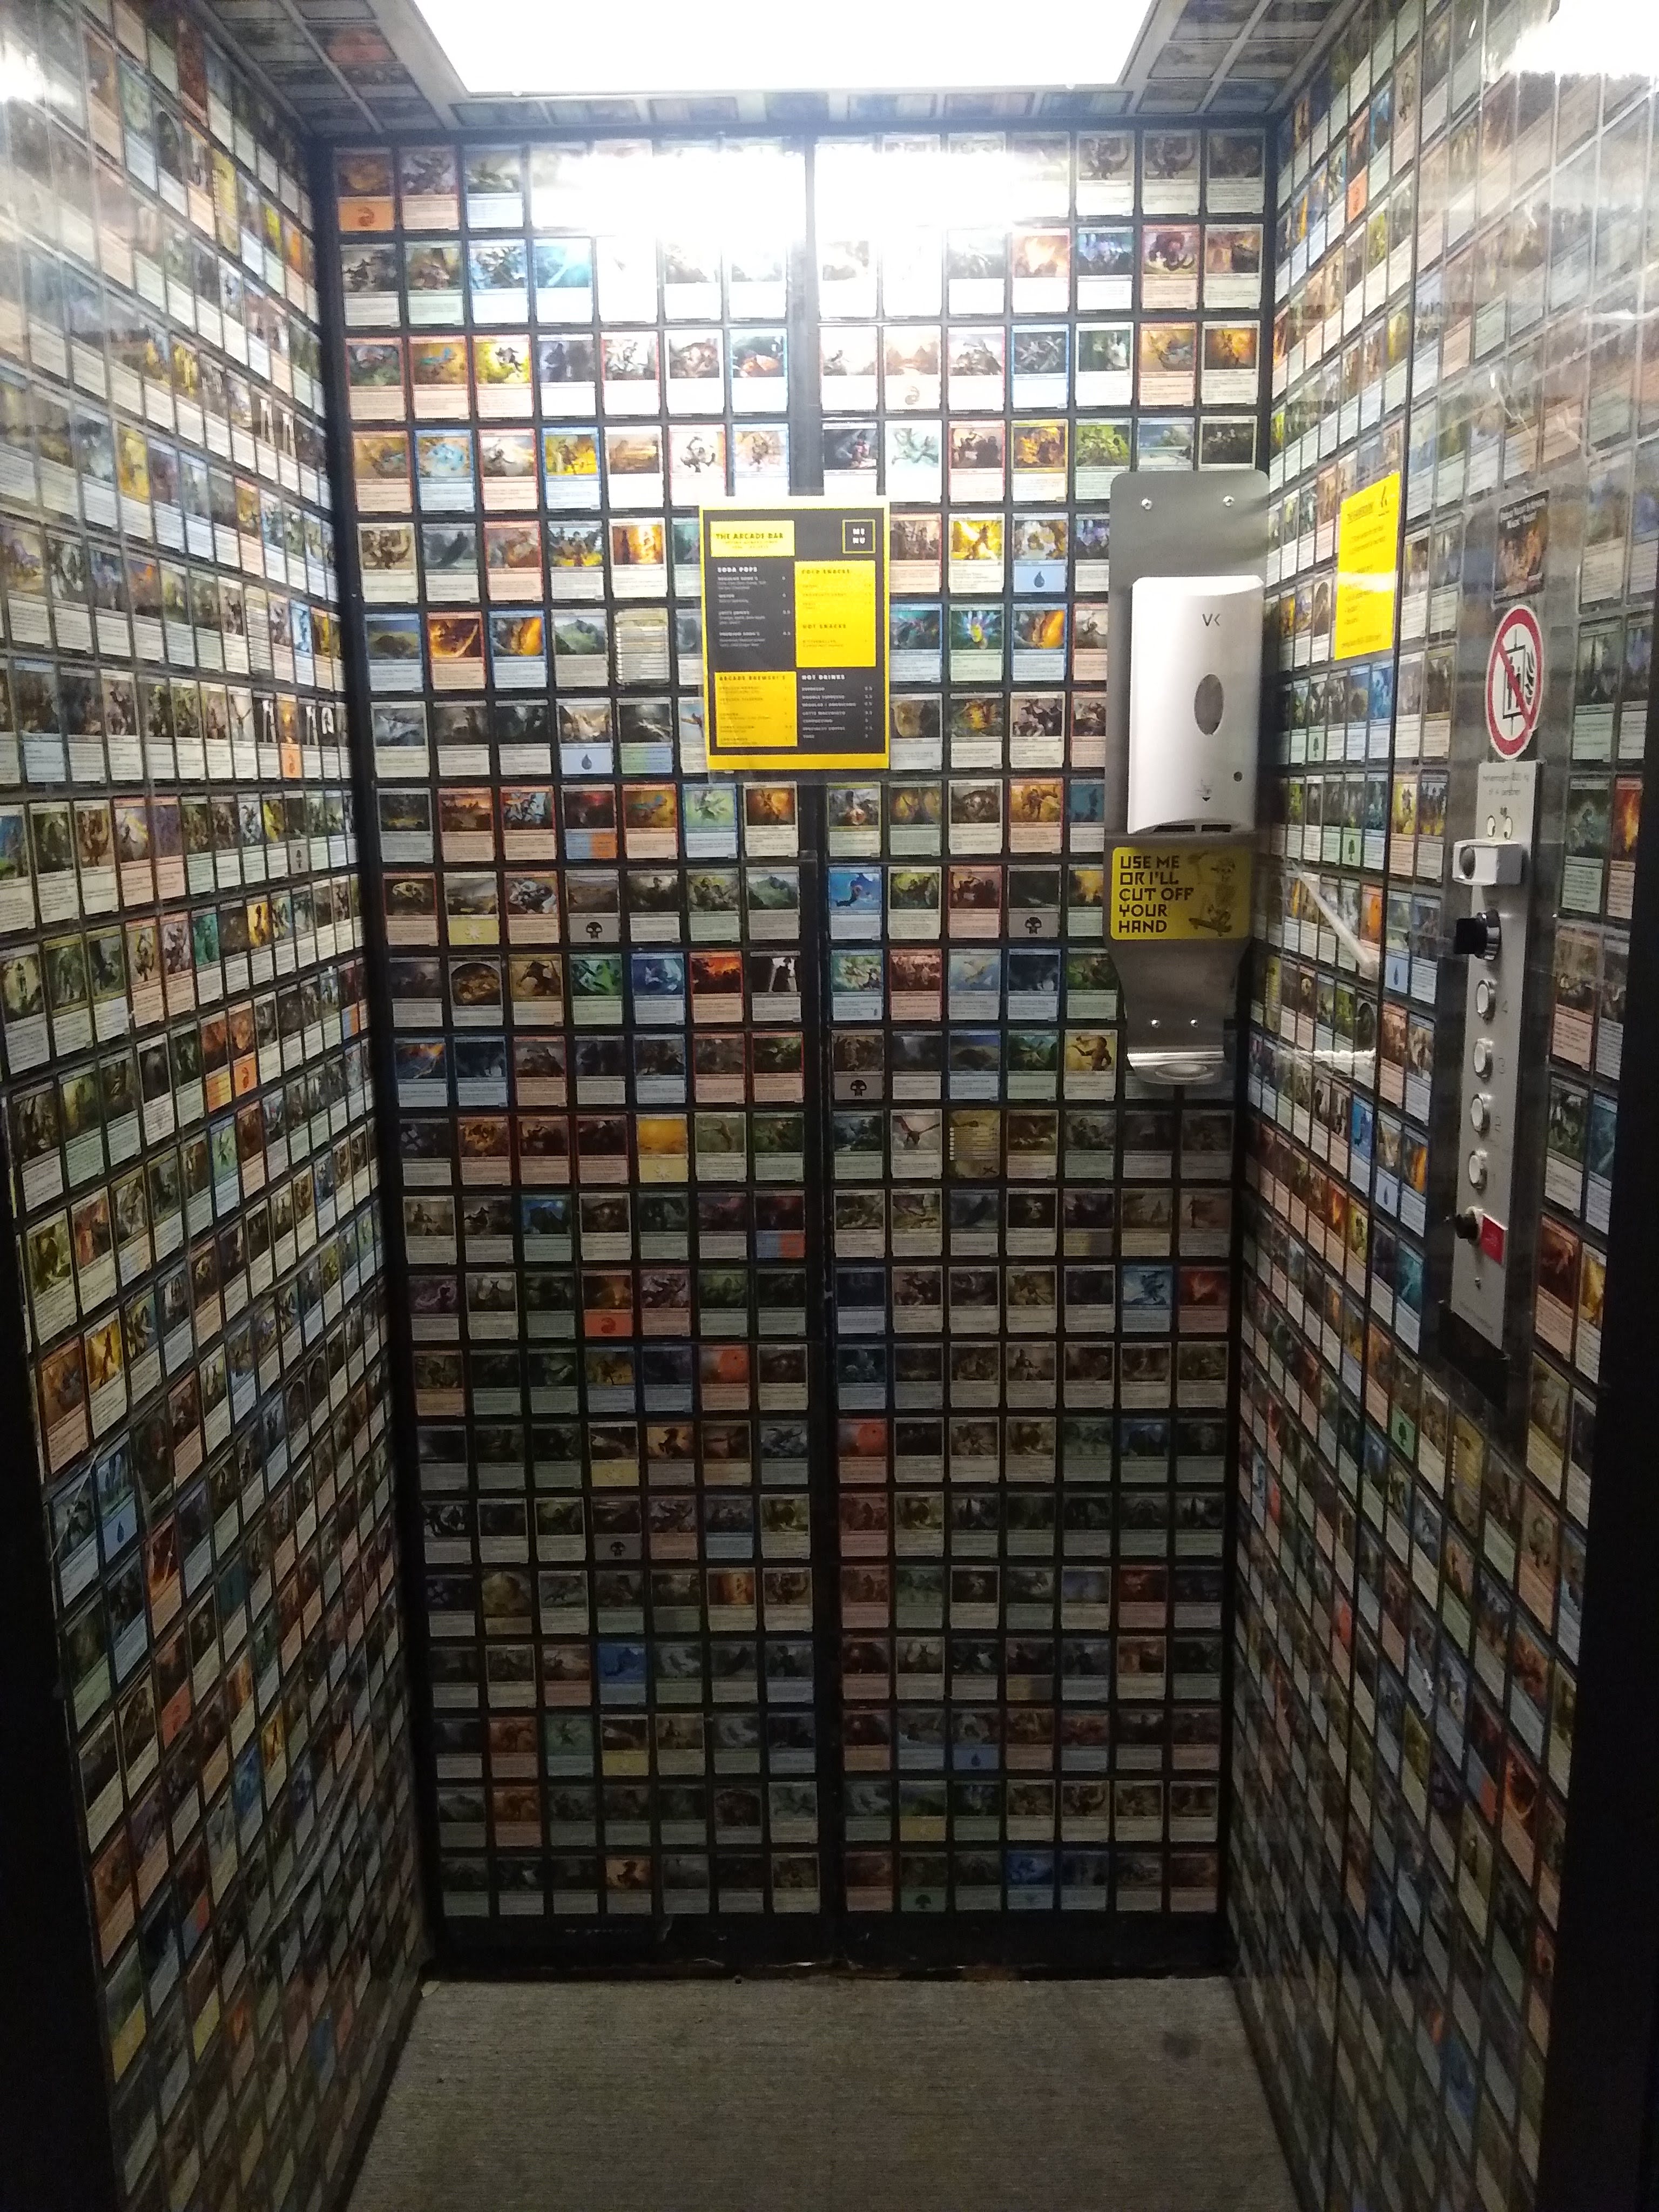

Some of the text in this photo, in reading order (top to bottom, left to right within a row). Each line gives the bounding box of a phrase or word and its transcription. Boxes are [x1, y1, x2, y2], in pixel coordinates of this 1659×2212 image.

[1120, 855, 1180, 869] USE ME
[1120, 872, 1179, 886] OR I'LL
[1119, 887, 1194, 901] CUT OFF
[1119, 903, 1168, 918] YOUR
[1118, 920, 1167, 933] HAND
[1496, 1056, 1505, 1074] 3
